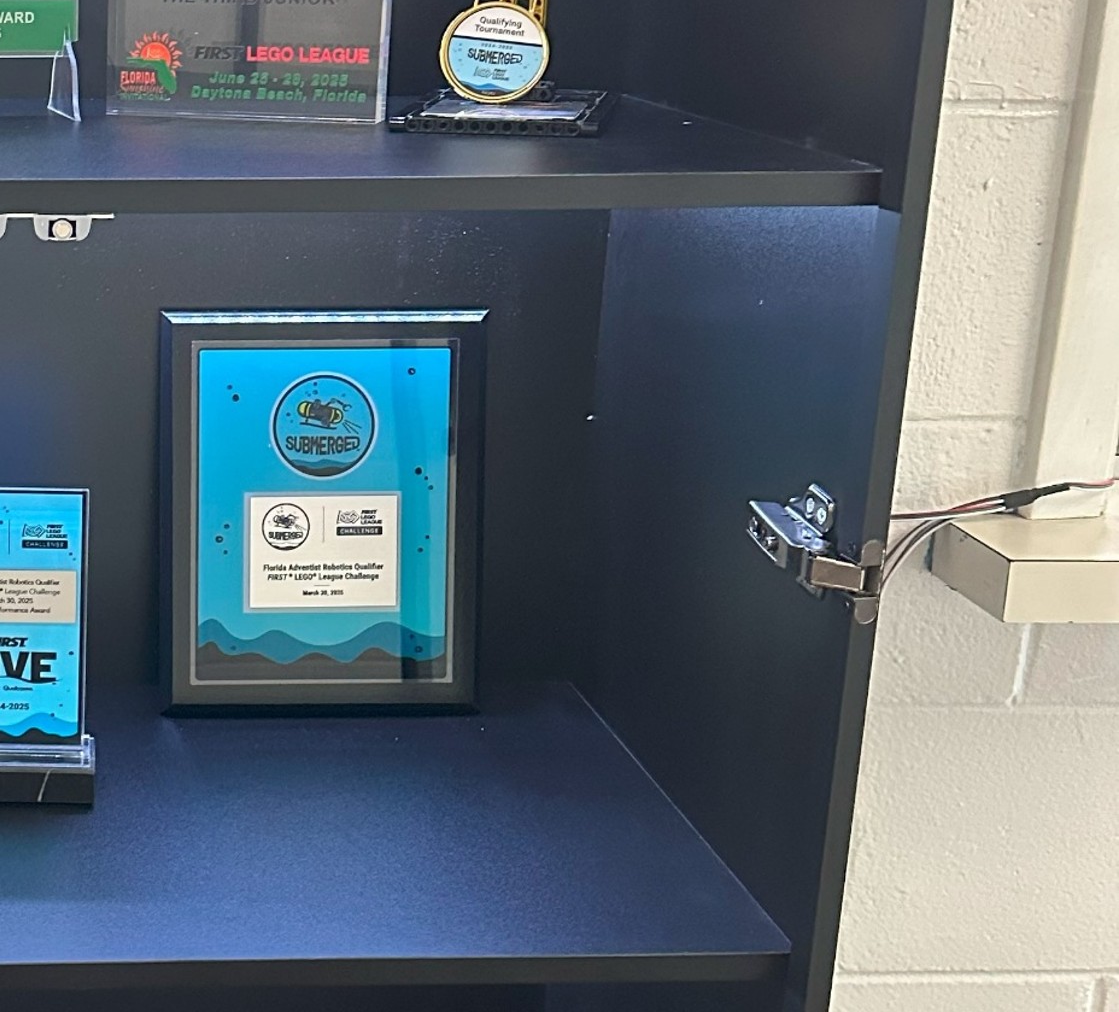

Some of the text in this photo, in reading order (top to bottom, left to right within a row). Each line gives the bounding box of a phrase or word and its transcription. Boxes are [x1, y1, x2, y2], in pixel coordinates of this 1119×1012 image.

[480, 16, 522, 29] Qualifying
[475, 24, 524, 36] Tournament
[194, 46, 370, 64] FIRST LEGO LEAGUE
[468, 48, 523, 65] SUBMERGED
[121, 70, 156, 84] FLORIDA
[209, 72, 245, 84] June
[191, 86, 367, 103] Daytona Beach, Florida
[286, 436, 360, 455] SUBMERGED
[263, 564, 286, 572] Florida
[318, 574, 343, 582] League
[345, 573, 379, 581] Challenge
[5, 588, 28, 596] League
[28, 588, 60, 596] Challenge
